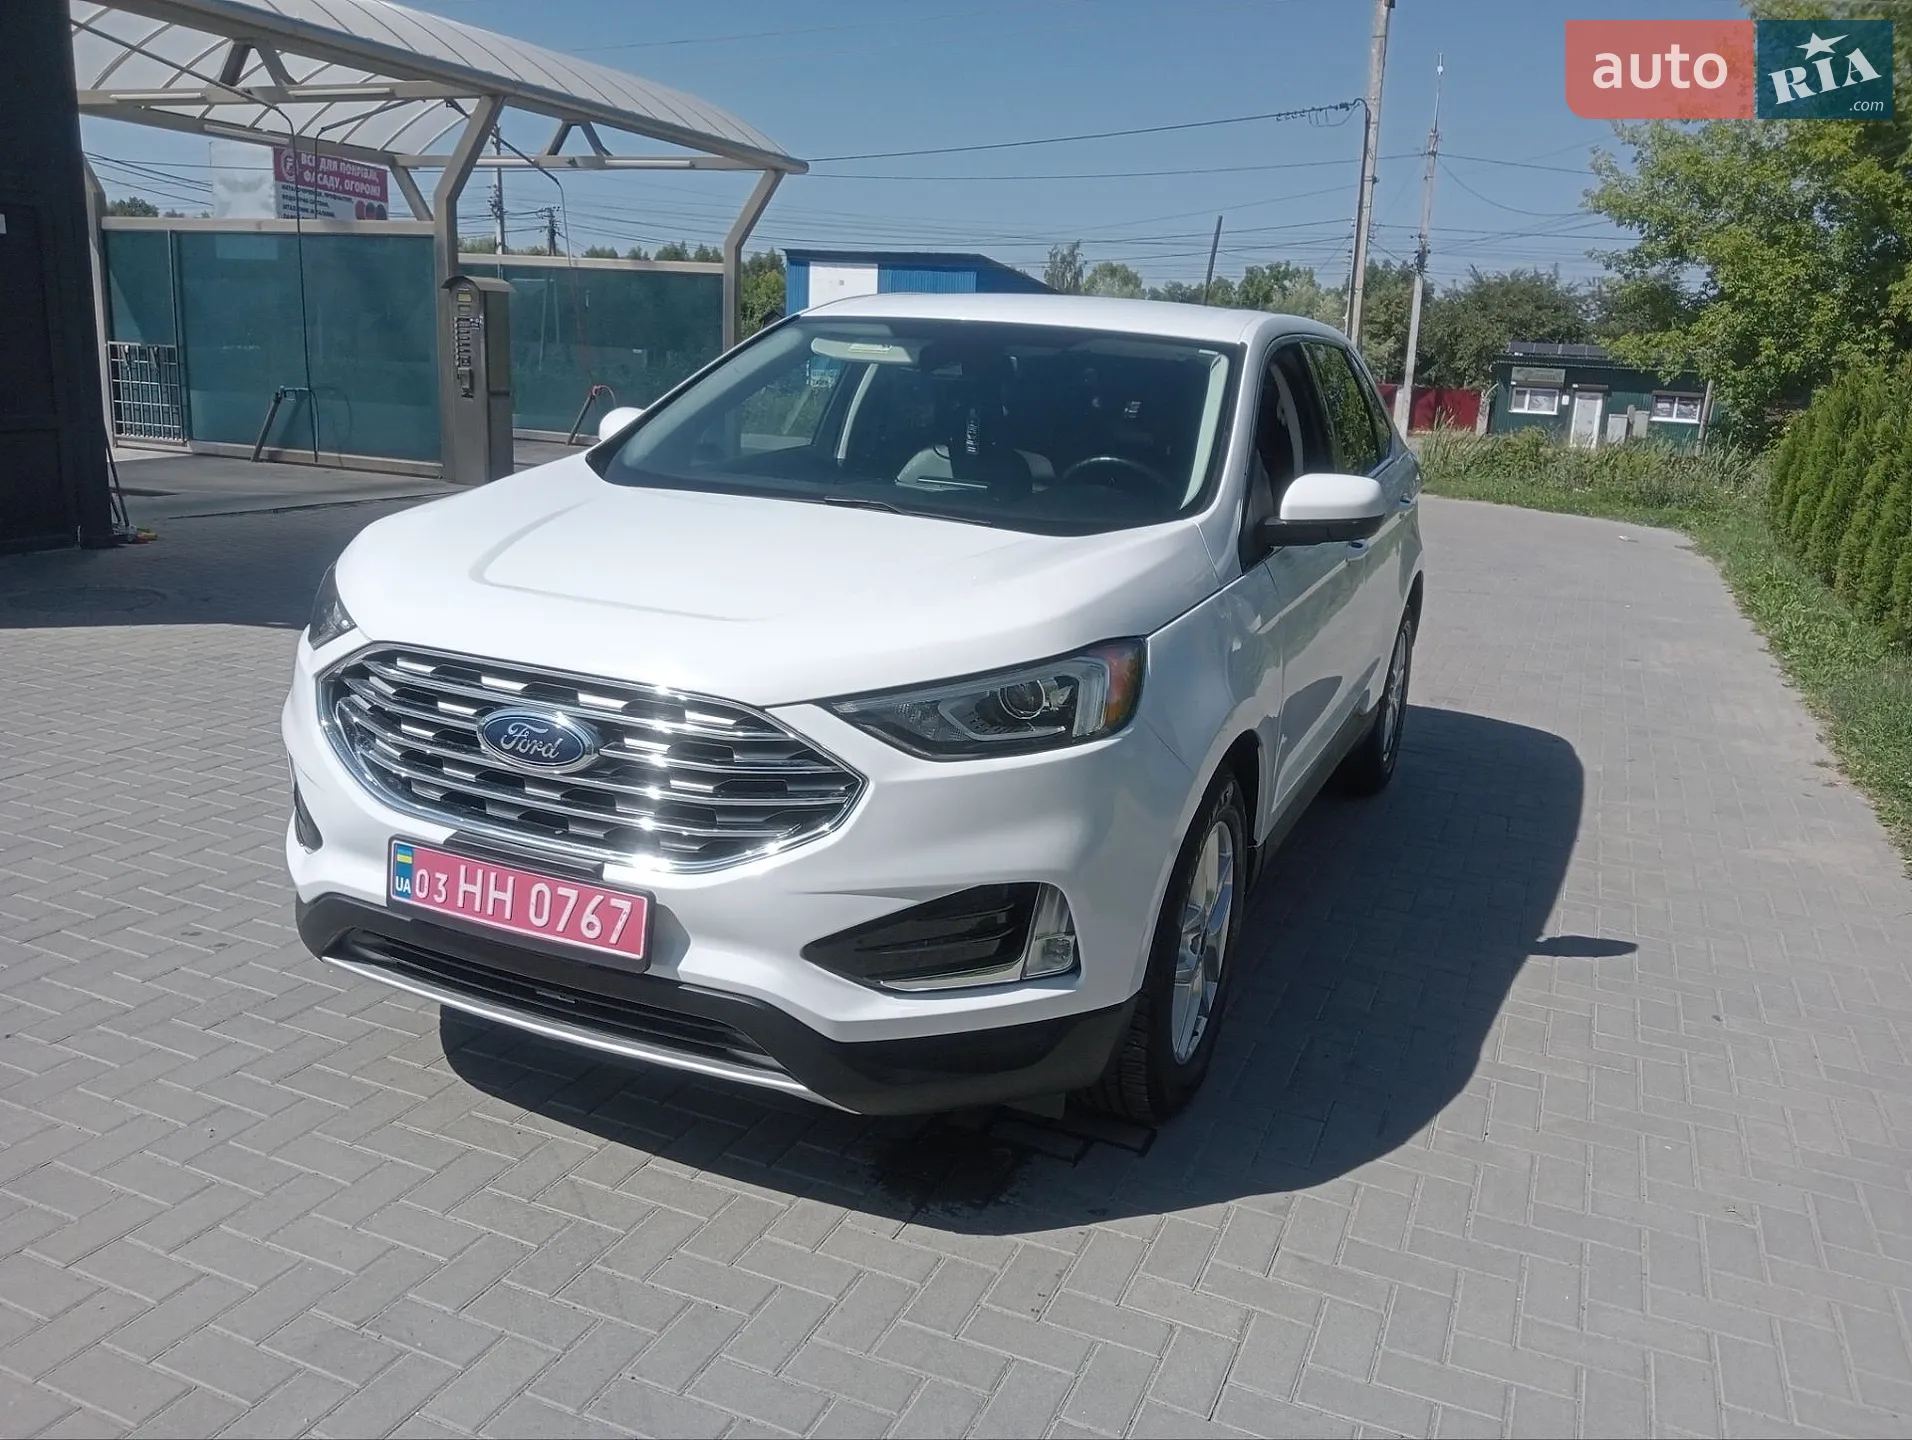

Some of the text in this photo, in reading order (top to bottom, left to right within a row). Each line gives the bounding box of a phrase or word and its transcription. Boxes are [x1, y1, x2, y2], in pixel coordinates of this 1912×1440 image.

[320, 157, 338, 172] ДЛЯ
[500, 722, 563, 759] Ford
[395, 876, 411, 894] UA
[415, 864, 632, 944] 03 HH 0767
